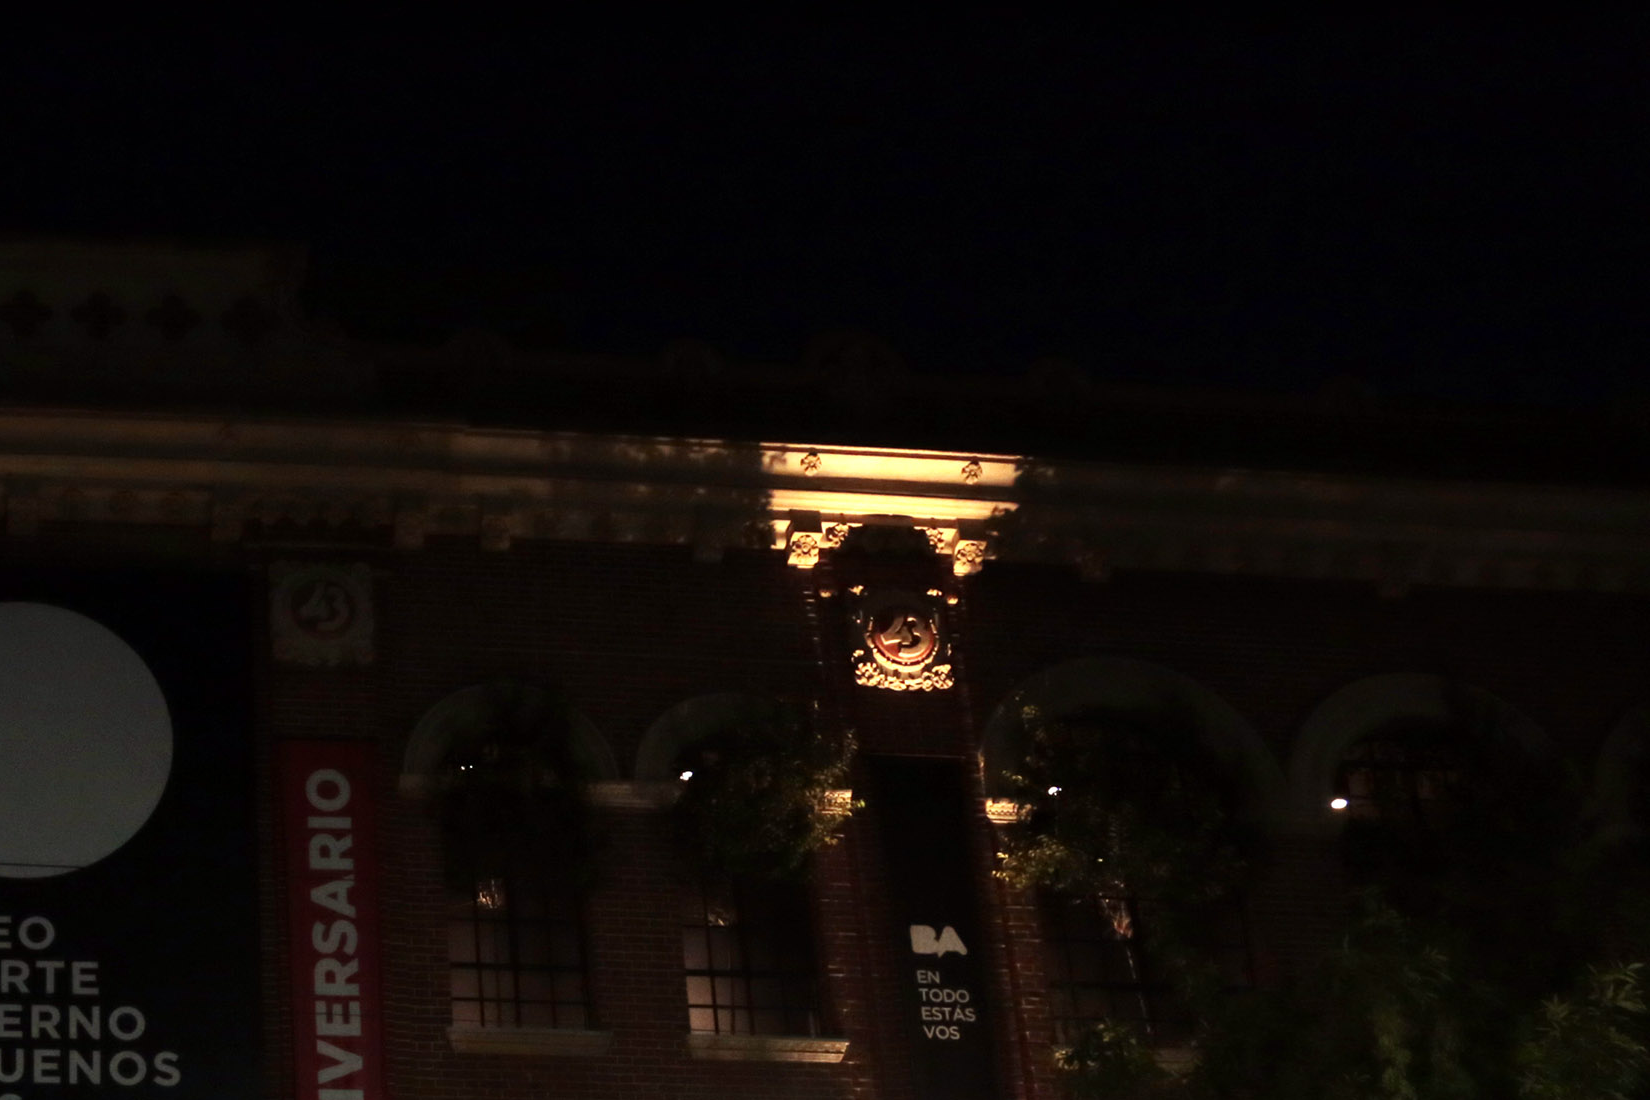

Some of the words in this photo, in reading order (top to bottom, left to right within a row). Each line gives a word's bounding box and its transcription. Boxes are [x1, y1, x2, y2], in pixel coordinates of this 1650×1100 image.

[910, 924, 968, 958] BA
[916, 969, 941, 984] EN
[918, 988, 970, 1003] TODO
[920, 1004, 977, 1022] ESTÁS
[922, 1025, 961, 1040] VOS
